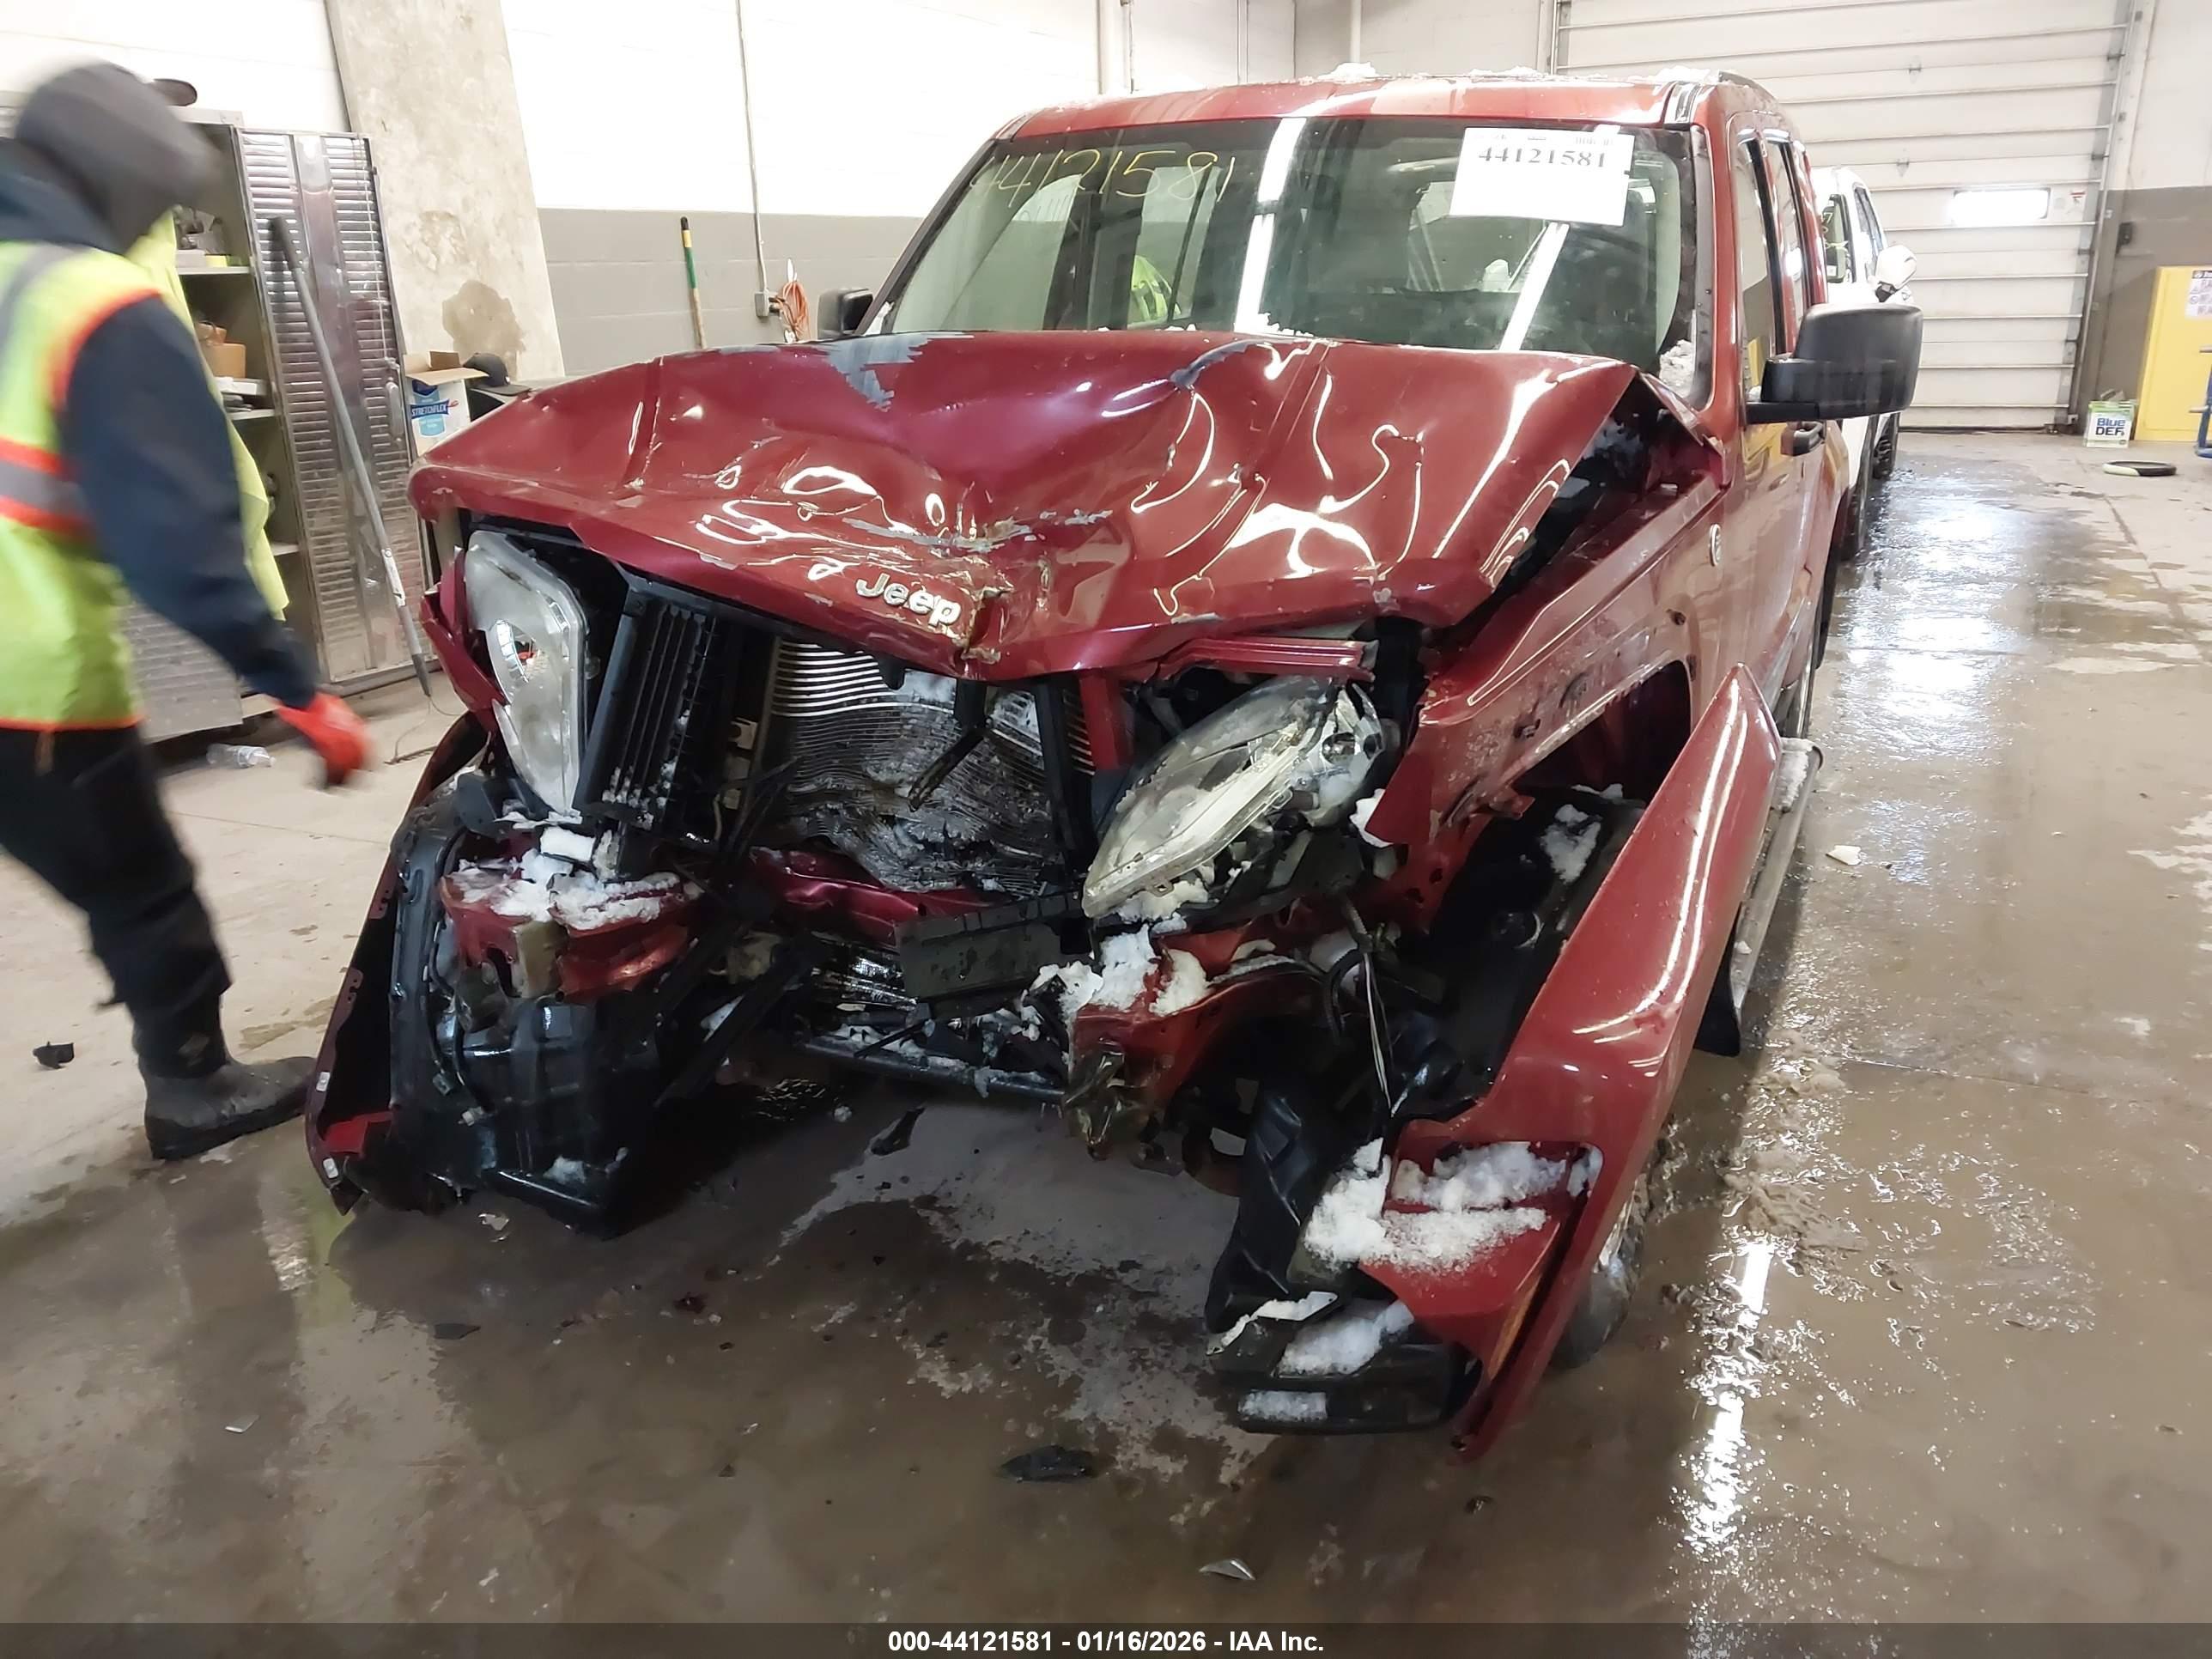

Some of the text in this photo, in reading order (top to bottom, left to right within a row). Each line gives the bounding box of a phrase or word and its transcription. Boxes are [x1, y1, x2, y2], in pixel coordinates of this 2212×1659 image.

[1478, 146, 1607, 168] 44121581
[2097, 417, 2126, 427] Blue
[855, 572, 963, 627] Jeep
